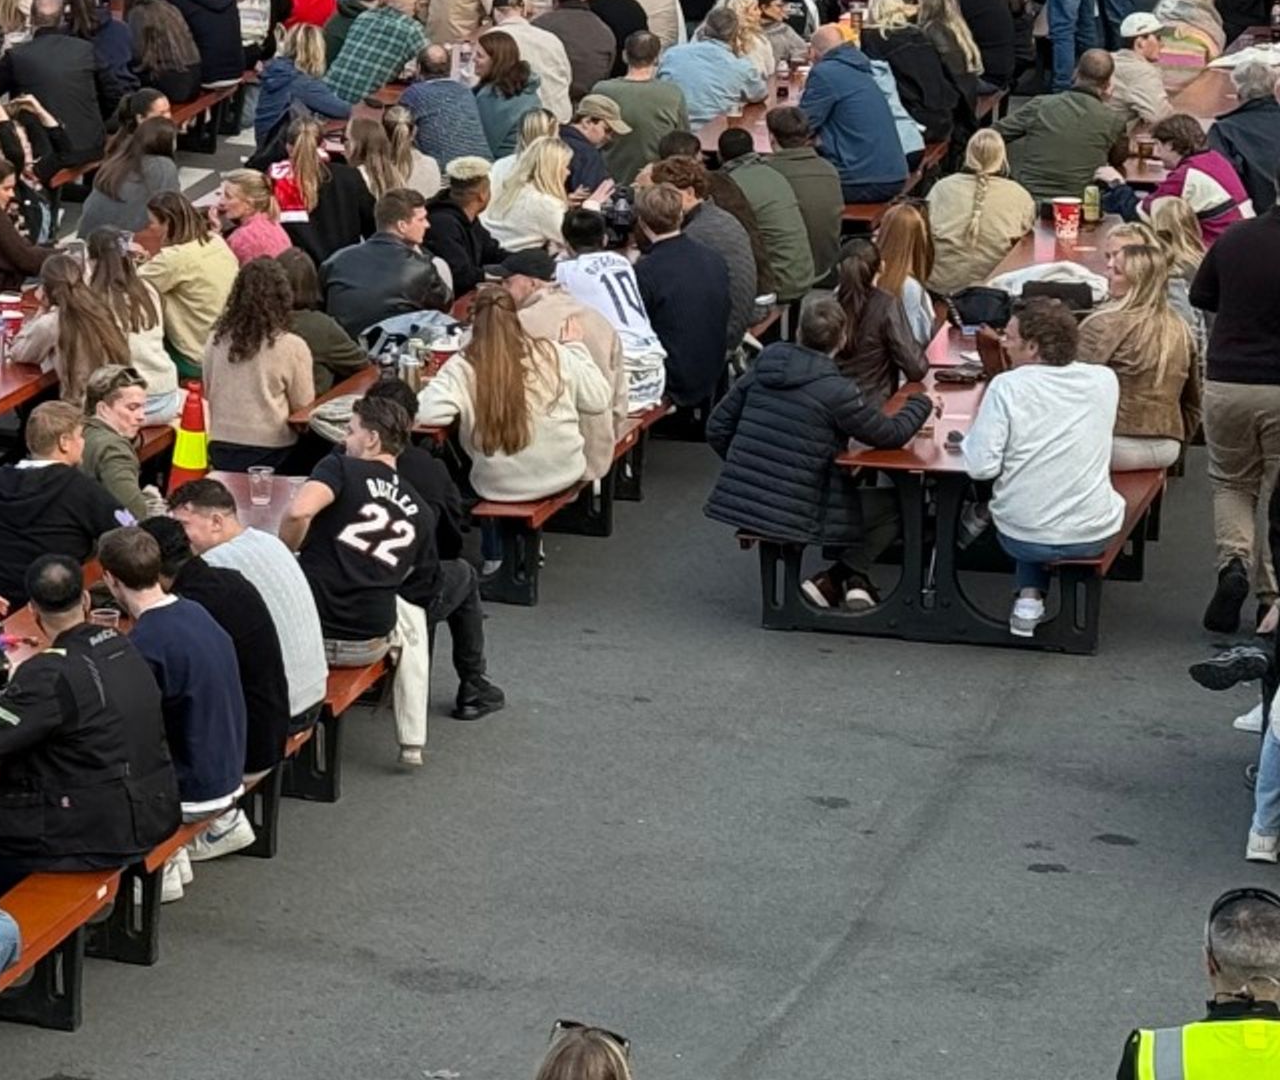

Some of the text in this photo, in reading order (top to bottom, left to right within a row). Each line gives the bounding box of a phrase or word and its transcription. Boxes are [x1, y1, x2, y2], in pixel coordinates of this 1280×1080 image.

[600, 270, 646, 326] 10
[366, 477, 419, 517] BUTLER
[339, 503, 416, 567] 22
